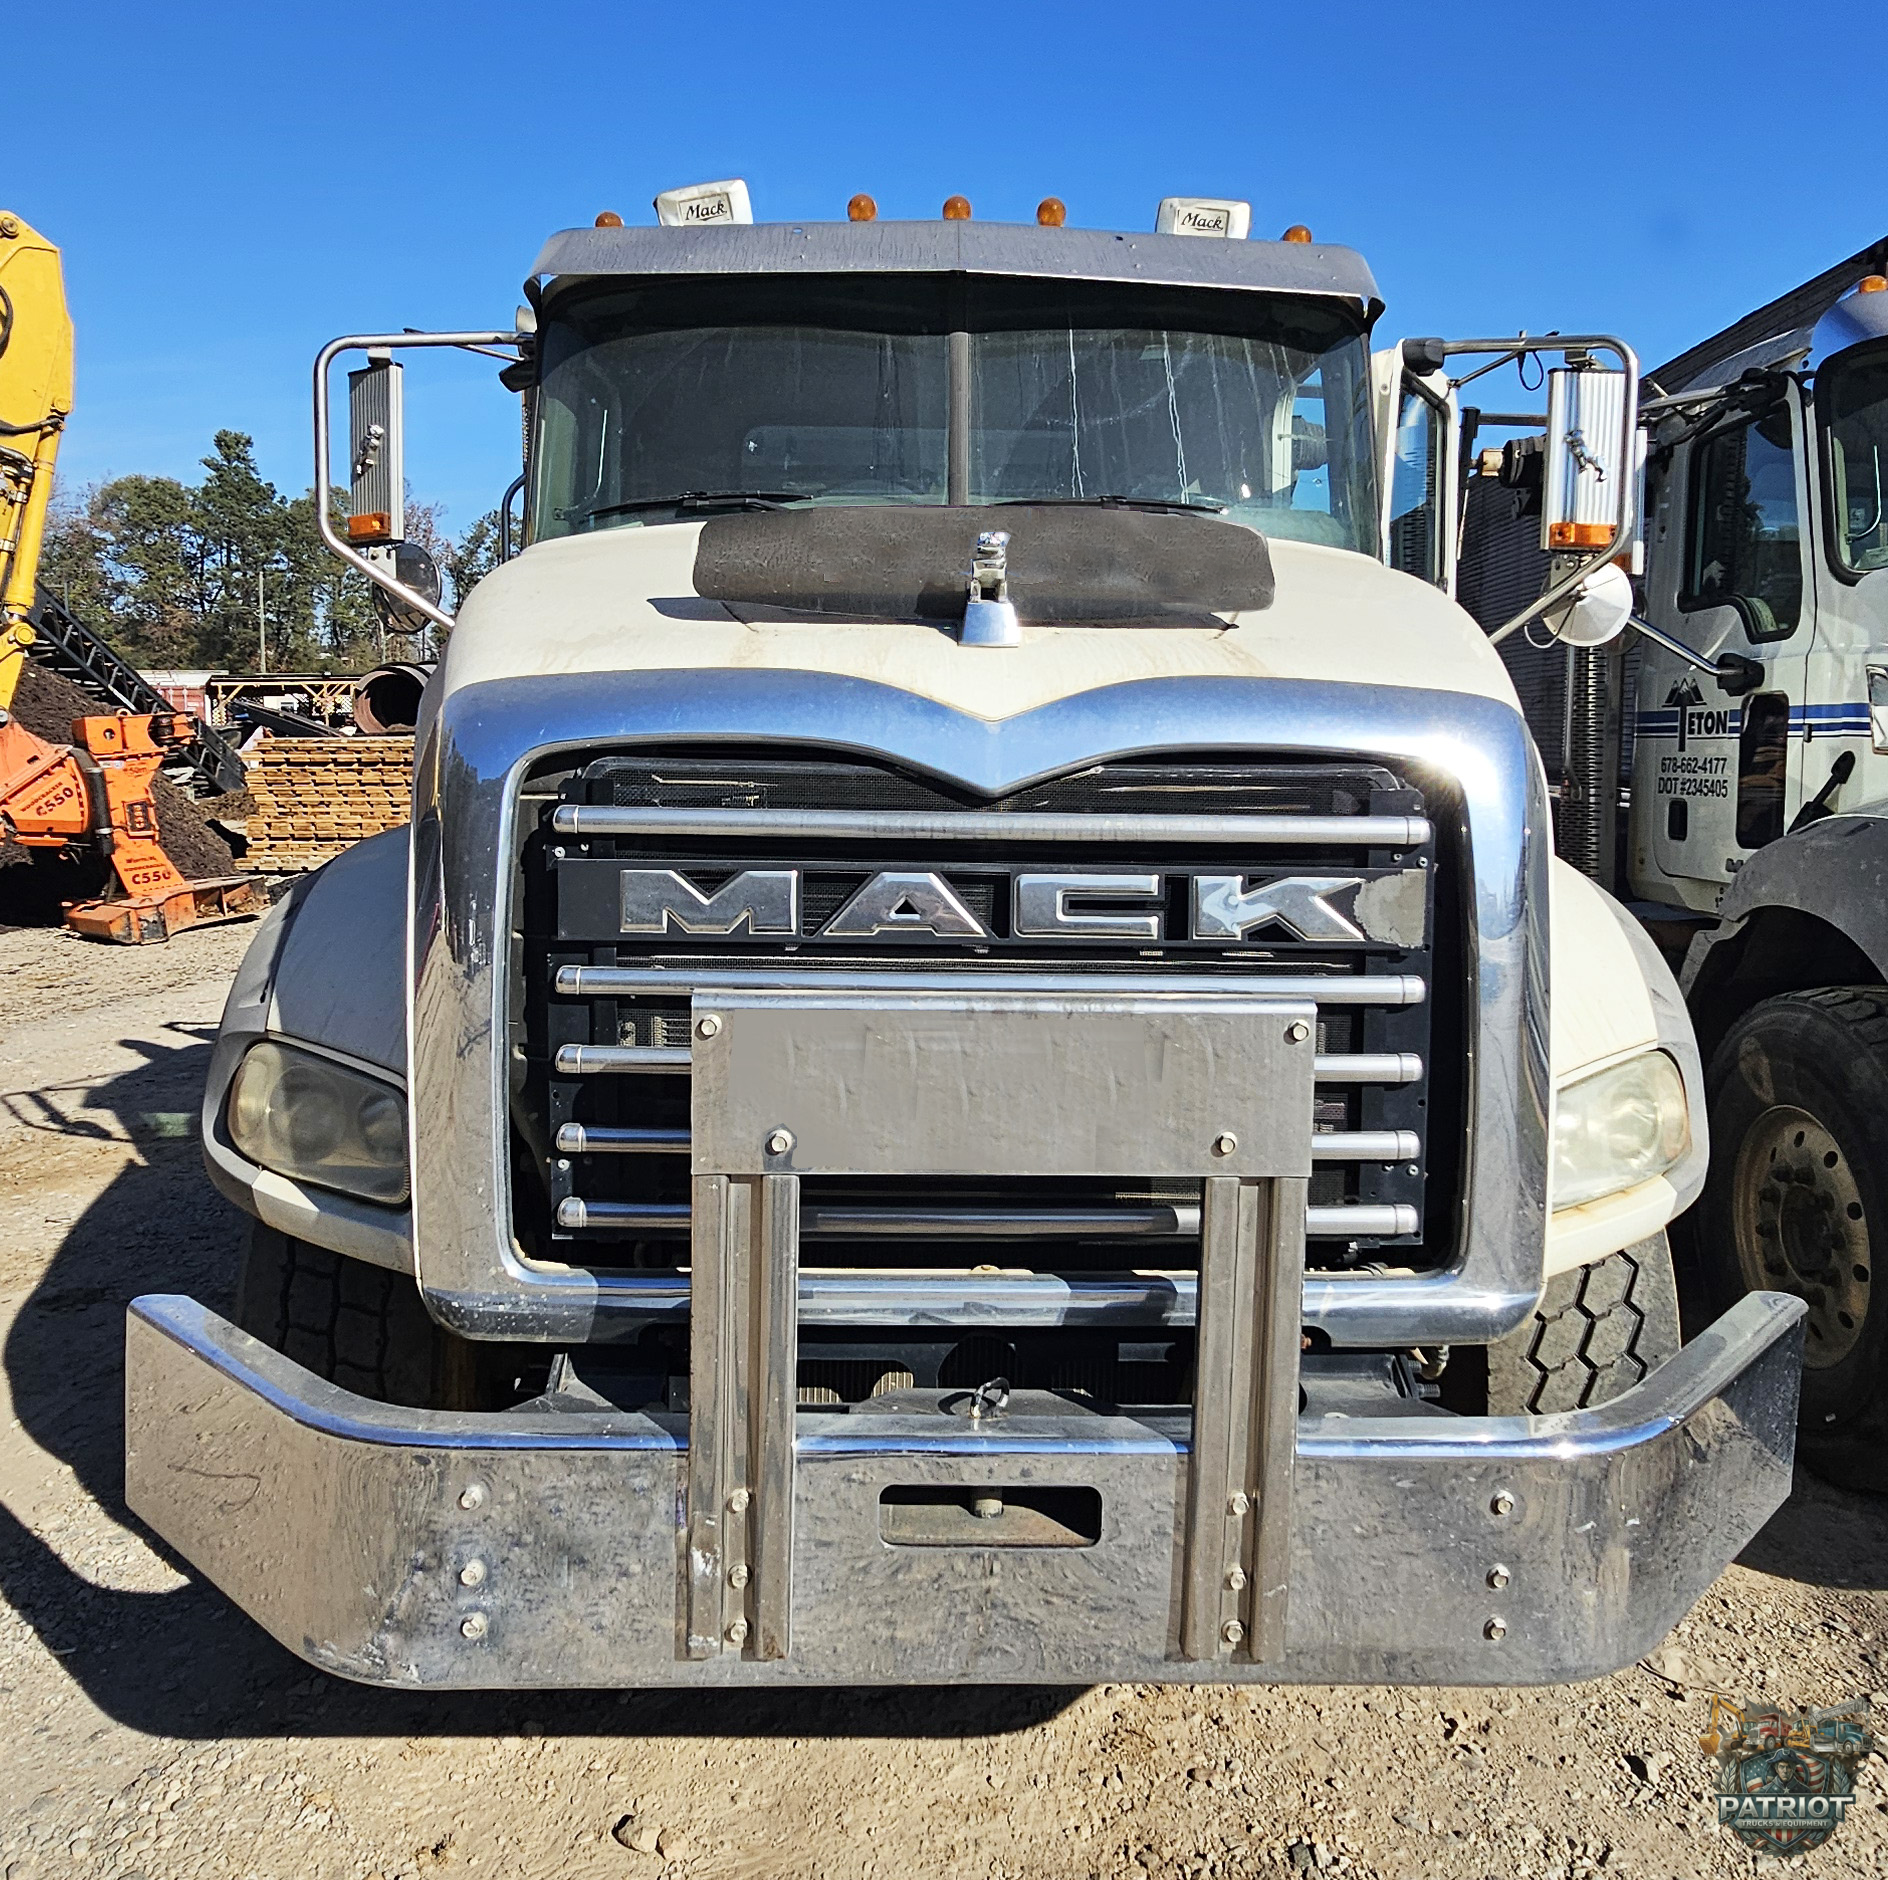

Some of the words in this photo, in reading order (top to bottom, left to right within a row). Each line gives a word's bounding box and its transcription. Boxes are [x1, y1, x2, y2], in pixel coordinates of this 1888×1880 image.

[685, 199, 728, 221] Mack
[1180, 211, 1224, 231] Mack
[1660, 756, 1728, 775] 678-662-4177
[1657, 777, 1680, 795] DOT
[36, 787, 74, 817] C550
[131, 869, 172, 885] C550
[619, 868, 1368, 942] MACK
